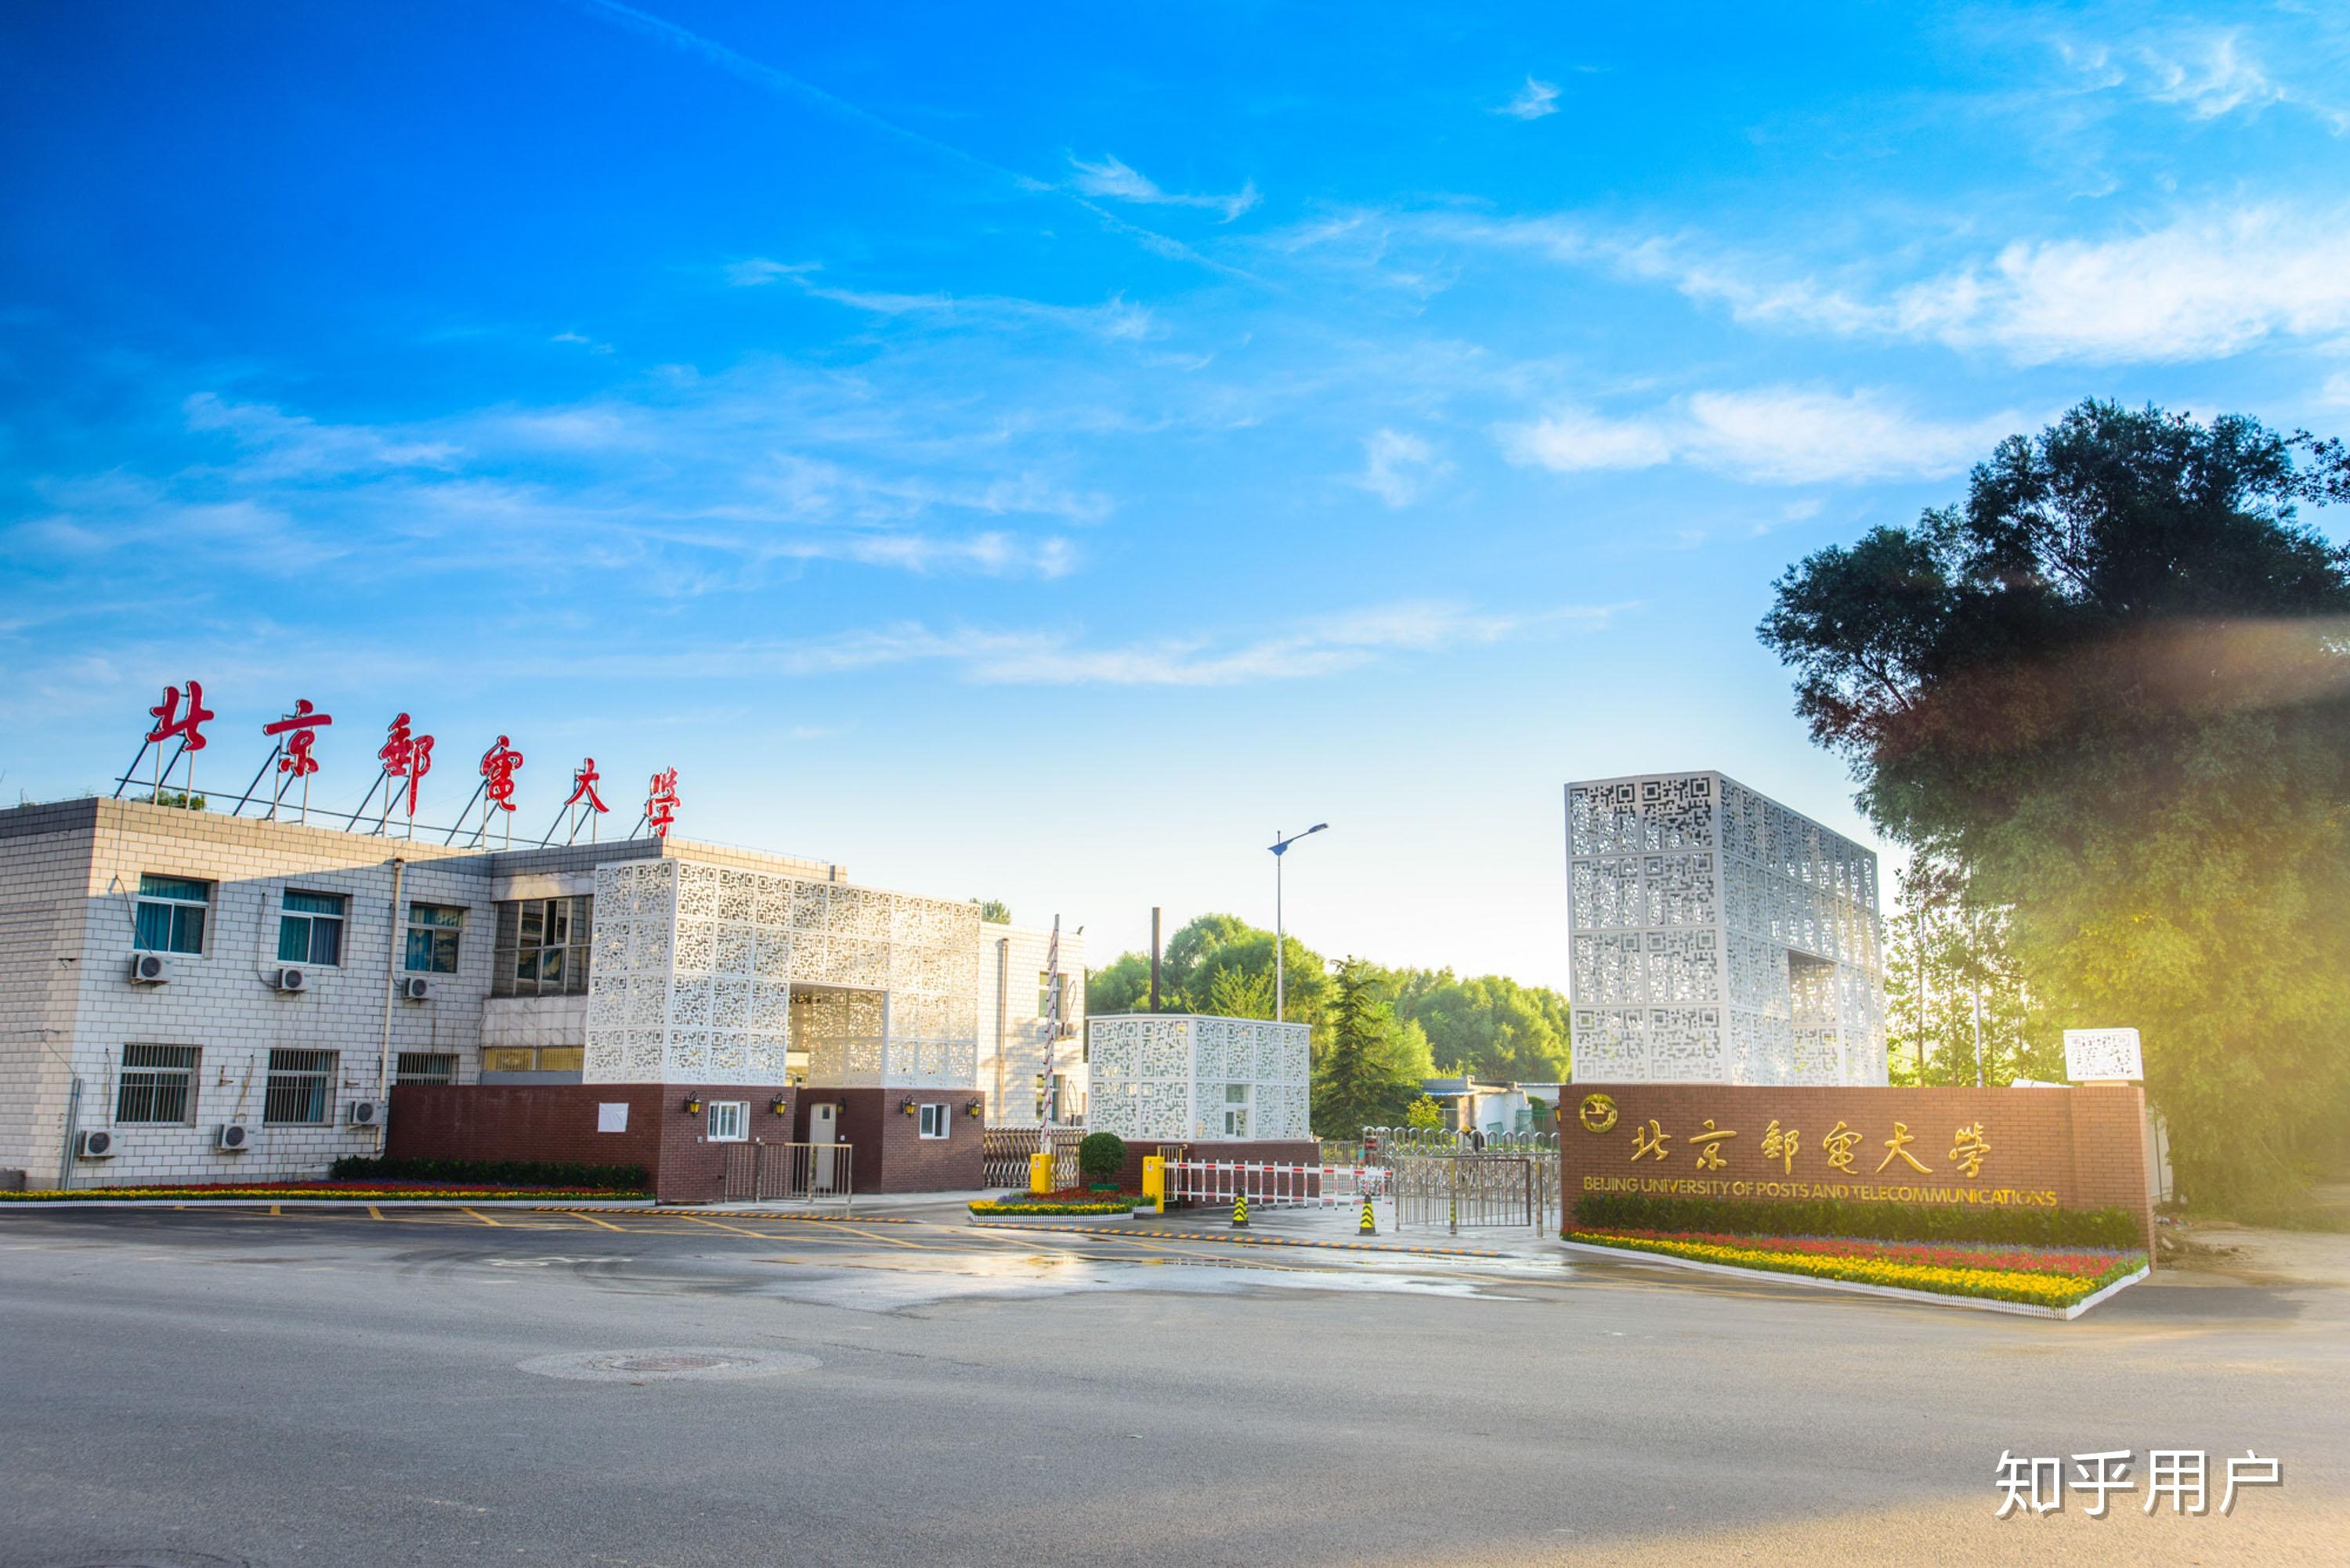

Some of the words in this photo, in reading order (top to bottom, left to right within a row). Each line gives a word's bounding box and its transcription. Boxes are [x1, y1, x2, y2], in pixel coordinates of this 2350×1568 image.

[1584, 1176, 1638, 1192] BEIJING
[1641, 1178, 1730, 1195] UNIVERSITY
[1733, 1181, 1755, 1196] OF
[1756, 1182, 1810, 1198] POSTS
[1812, 1183, 1848, 1198] AND
[1851, 1184, 2057, 1206] TELECOMMUNICATIONS
